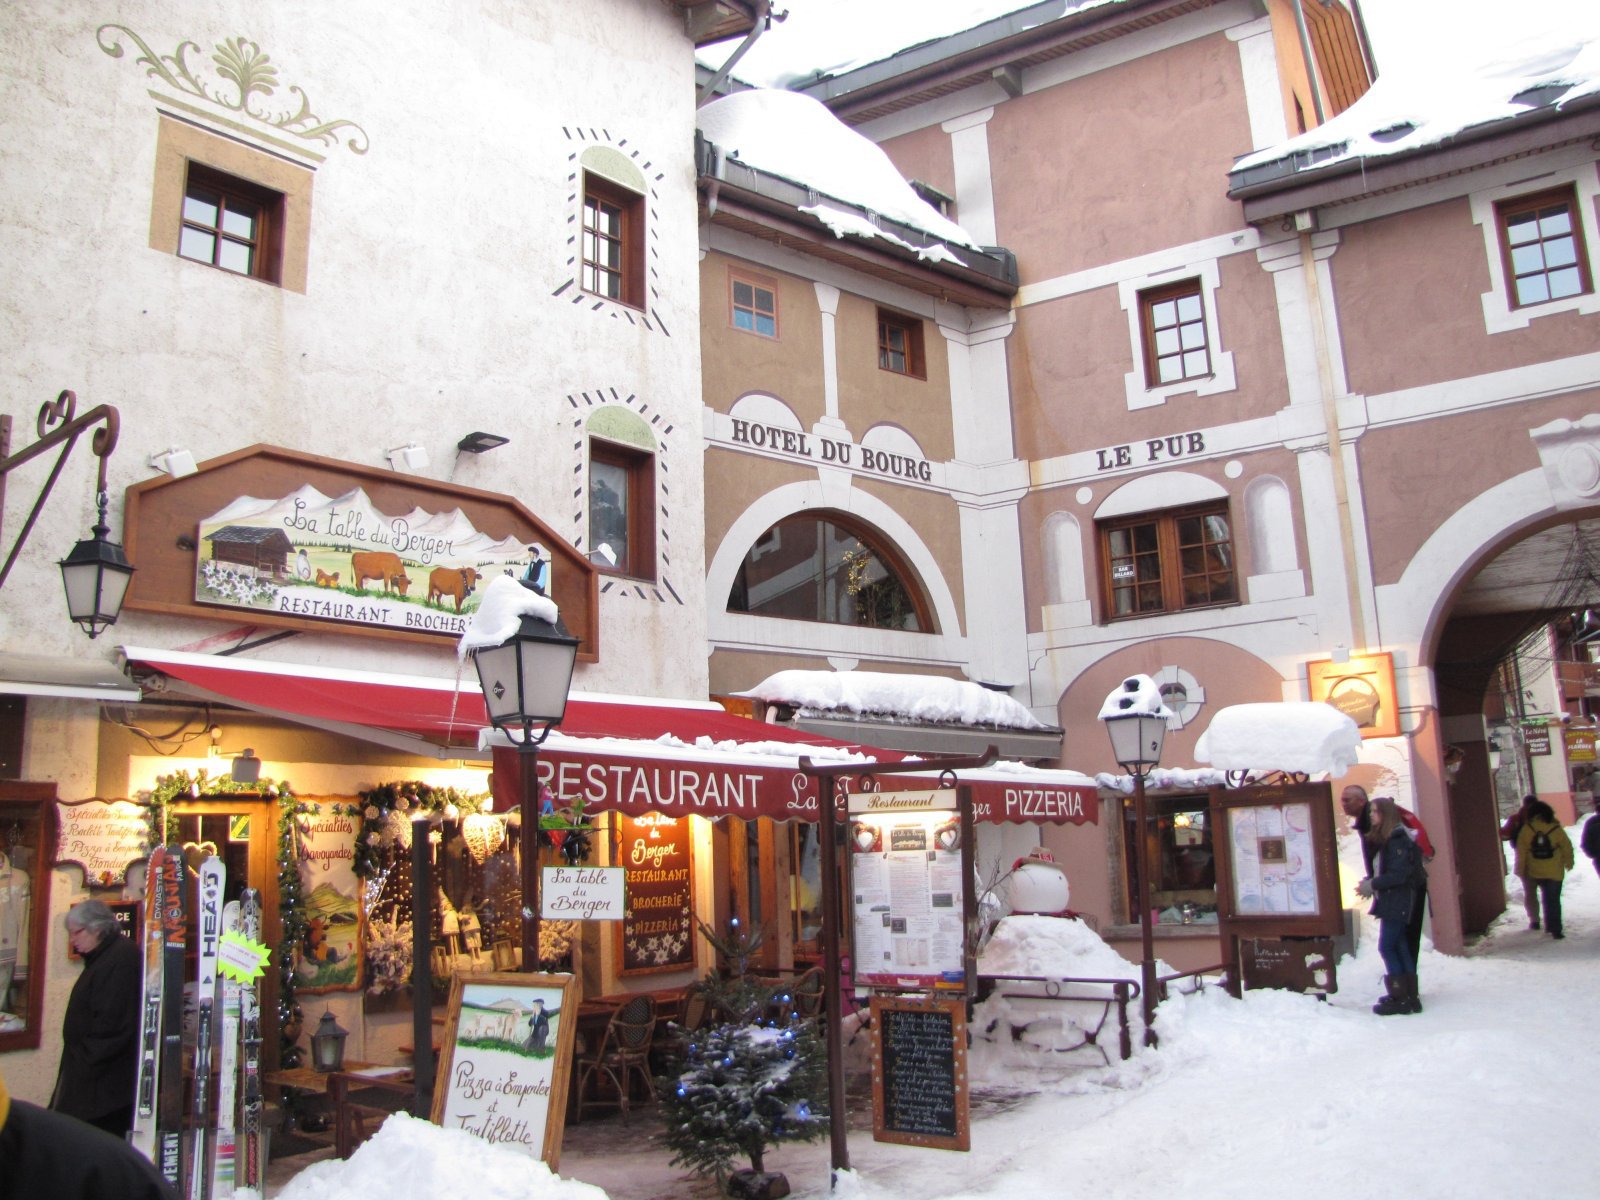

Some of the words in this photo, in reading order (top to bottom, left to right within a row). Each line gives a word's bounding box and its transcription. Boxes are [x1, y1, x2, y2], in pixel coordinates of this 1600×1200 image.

[731, 419, 812, 456] HOTEL
[820, 438, 851, 464] DU
[861, 447, 932, 482] BOURG
[1096, 445, 1131, 471] LE
[1146, 432, 1205, 461] PUB
[283, 498, 318, 534] La
[324, 507, 366, 541] table
[370, 523, 389, 545] du
[391, 518, 456, 564] Berger
[280, 596, 392, 623] RESTAURANT
[537, 761, 763, 808] RESTAURANT
[787, 772, 819, 810] La
[1005, 788, 1084, 817] PIZZERIA
[867, 794, 935, 809] Restaurant
[632, 838, 680, 867] Berger
[551, 868, 571, 885] La
[576, 868, 608, 885] table
[626, 869, 689, 883] RESTAURANT
[155, 866, 164, 919] DYNASTA
[572, 886, 587, 897] du
[551, 896, 612, 919] Berger
[456, 1060, 493, 1099] Pizza
[495, 1077, 502, 1092] à
[503, 1070, 551, 1108] Emporter
[486, 1098, 498, 1113] et
[456, 1114, 533, 1145] Tartiflette
